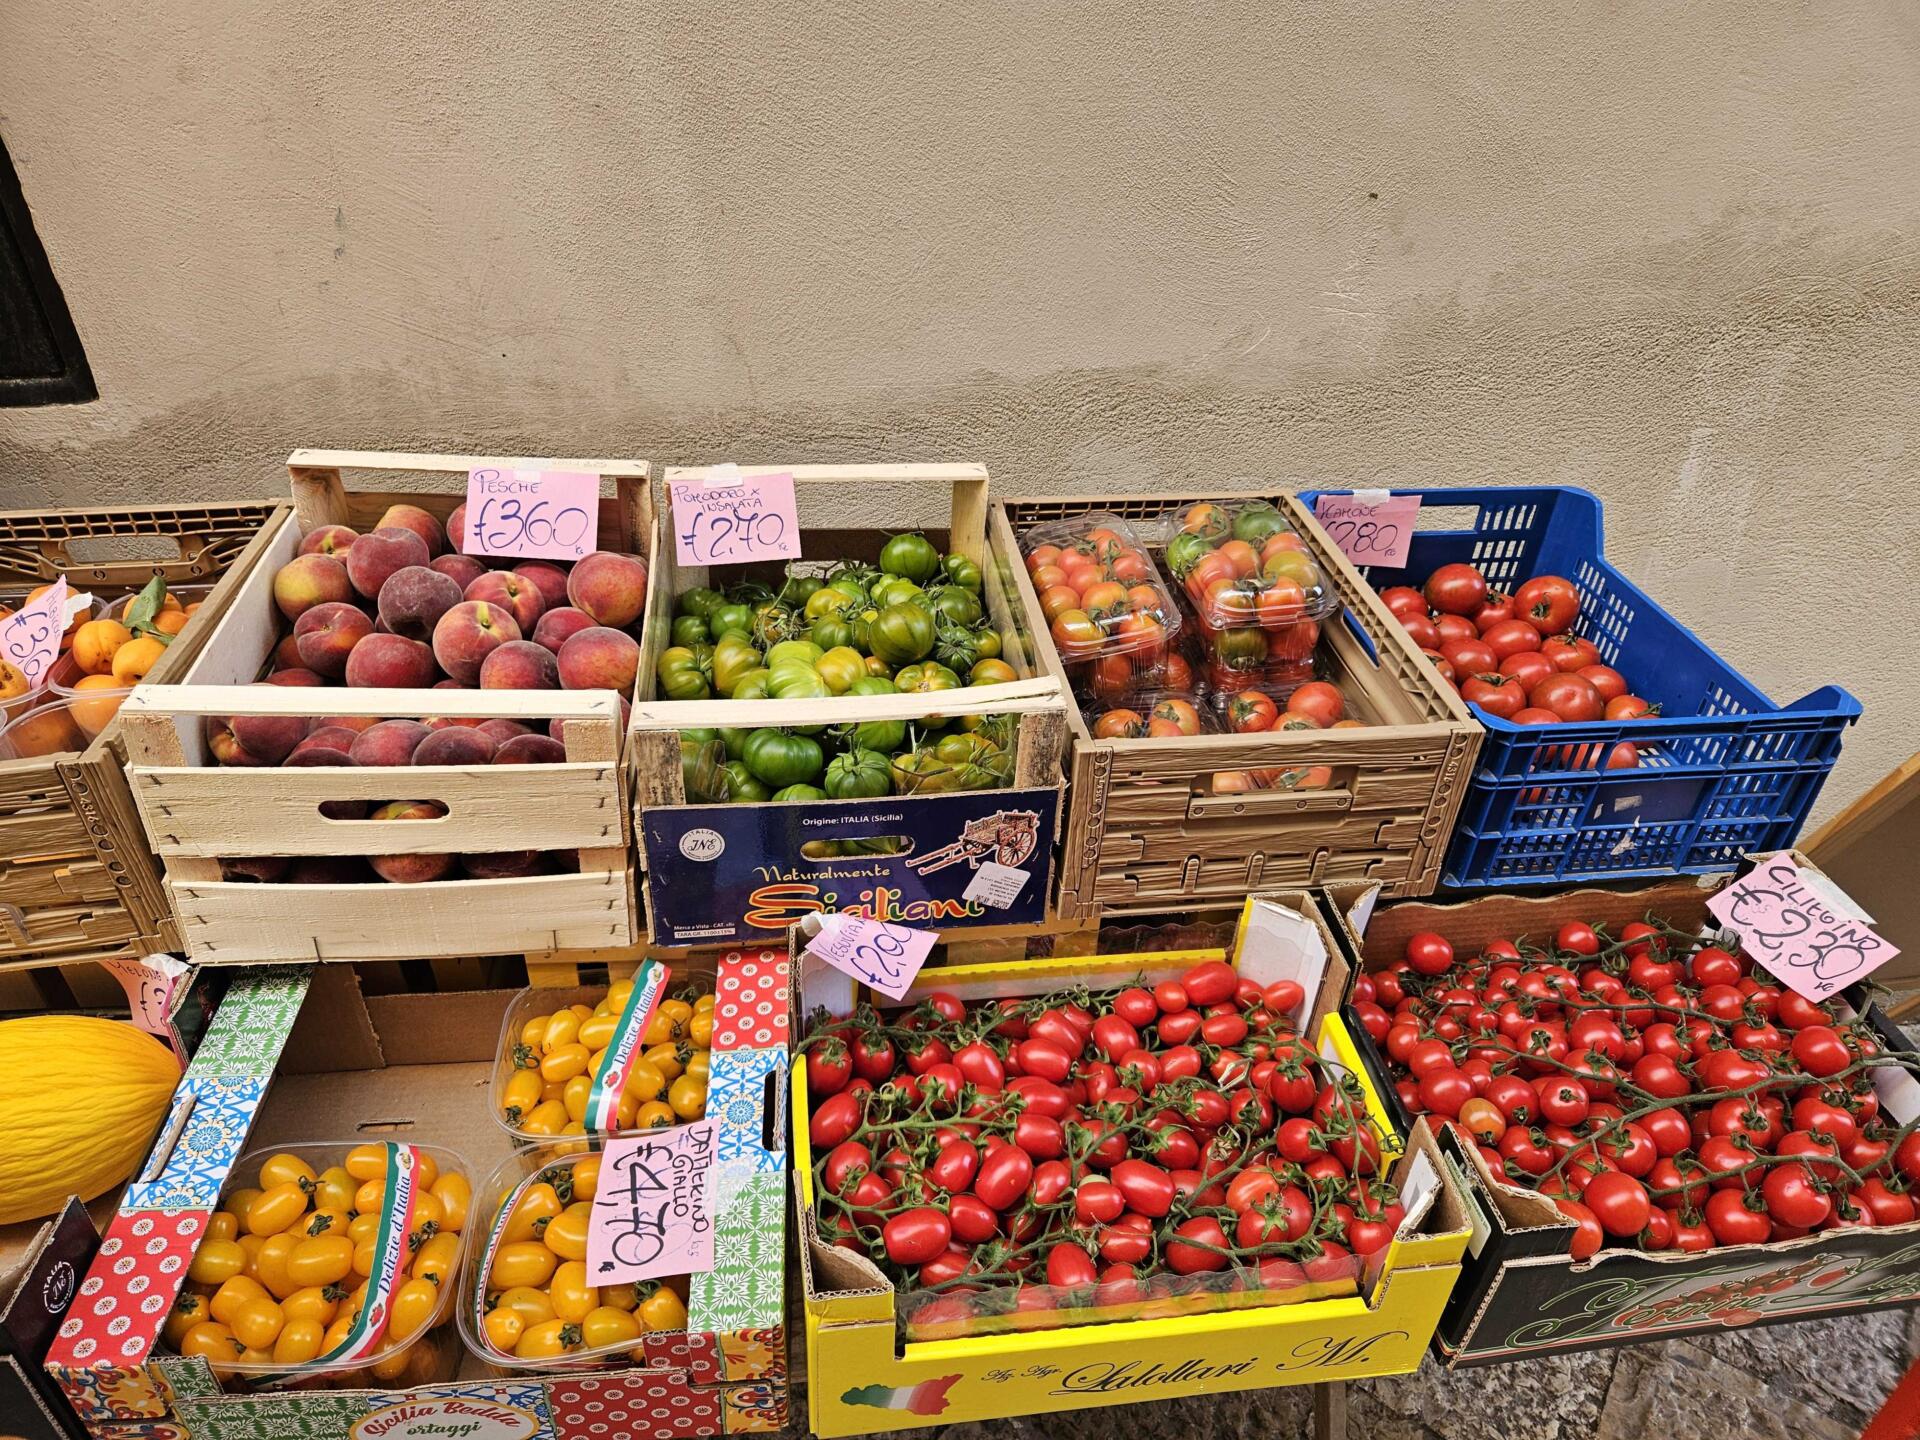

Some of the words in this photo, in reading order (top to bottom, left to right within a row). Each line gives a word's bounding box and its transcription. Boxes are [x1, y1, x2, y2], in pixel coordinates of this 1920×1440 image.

[473, 469, 543, 494] PESCHE
[701, 498, 763, 513] INSALATA
[473, 498, 589, 552] €3,60
[682, 509, 785, 562] €2,70
[688, 829, 714, 837] ITALIA
[802, 818, 840, 826] Origine:
[840, 815, 870, 824] ITALIA
[871, 813, 904, 823] (Sicilia)
[752, 864, 891, 882] Naturalmente
[614, 1025, 640, 1066] Delizie
[631, 985, 657, 1025] d'Italia
[672, 1154, 694, 1218] GIALLO
[378, 1235, 401, 1295] Delizie
[391, 1175, 411, 1234] d'Italia
[43, 1260, 63, 1294] ITALIA
[1276, 1330, 1409, 1370] M.
[363, 1406, 438, 1438] Sicilia
[443, 1401, 521, 1428] Bedda
[406, 1421, 483, 1438] ortaggi
